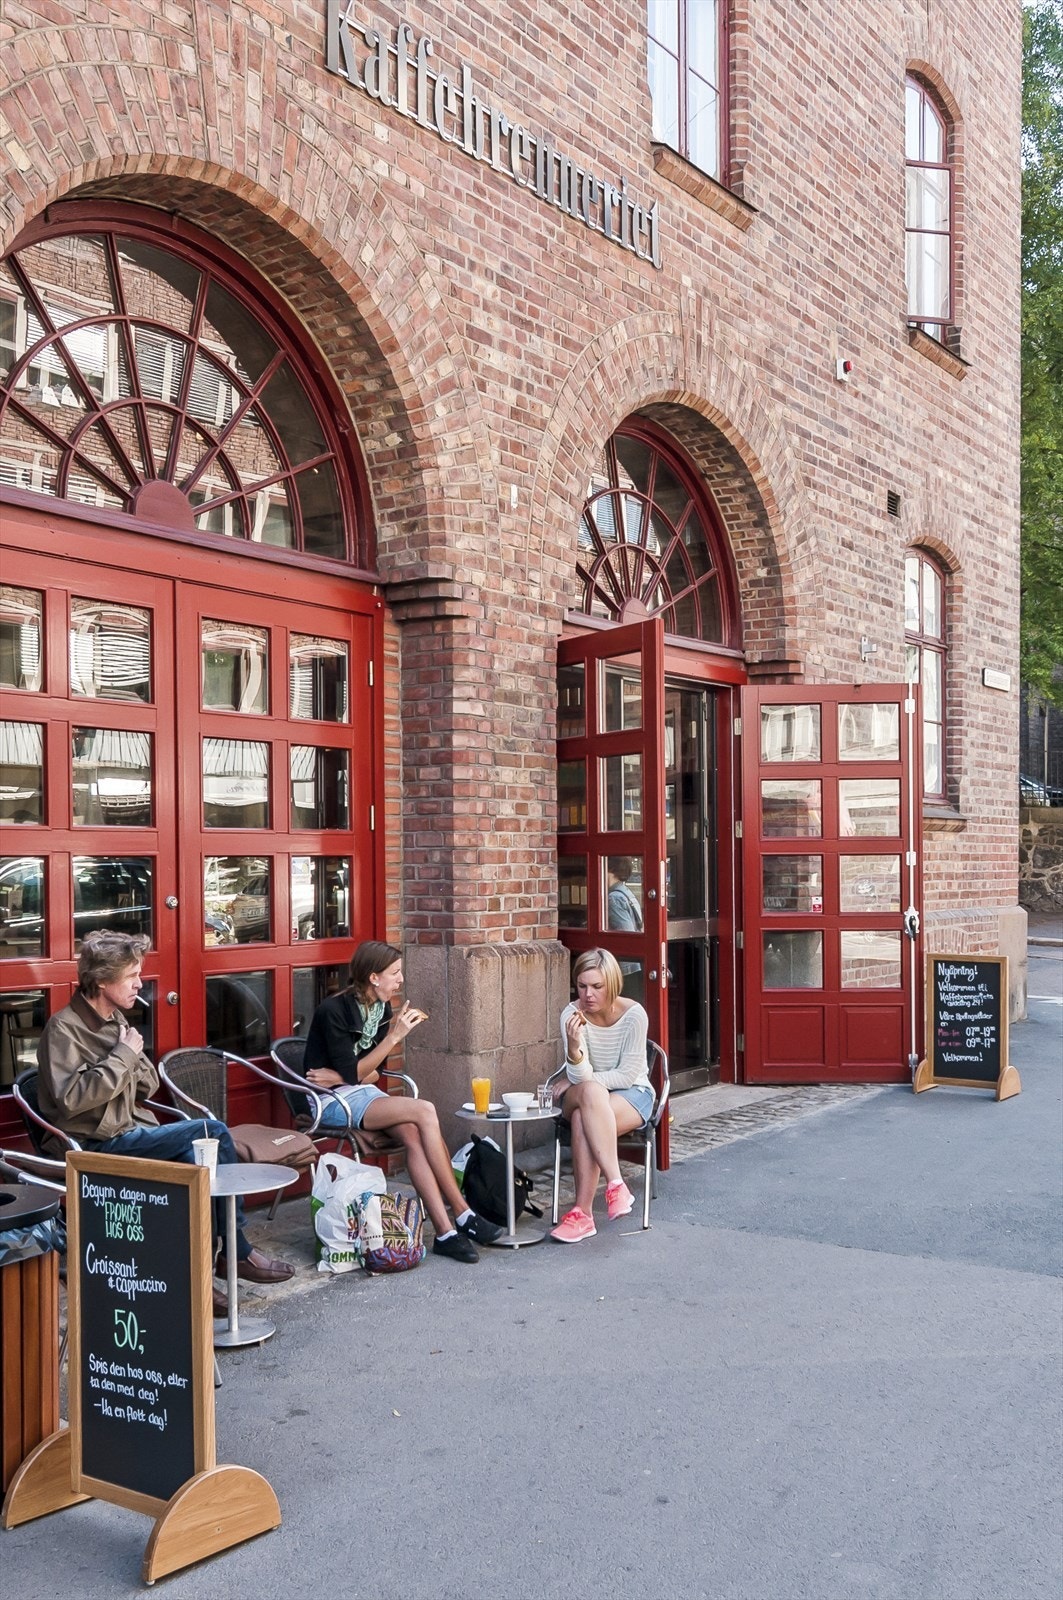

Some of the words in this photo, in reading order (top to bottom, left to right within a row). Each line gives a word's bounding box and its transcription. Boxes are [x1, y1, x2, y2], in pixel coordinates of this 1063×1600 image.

[325, 0, 662, 269] Kaffebrenneriet
[938, 962, 978, 982] Nyåpning!
[938, 982, 976, 991] Velkommen
[942, 1052, 983, 1062] Velkommen!
[82, 1174, 116, 1206] Begynn
[120, 1187, 147, 1206] dagen
[149, 1193, 169, 1206] med
[104, 1202, 143, 1225] FROKOST
[105, 1221, 124, 1239] HOS
[127, 1225, 144, 1242] OSS
[86, 1242, 138, 1278] Croissant
[89, 1353, 108, 1374] Spis
[110, 1362, 126, 1377] den
[127, 1363, 143, 1380] hos
[145, 1369, 167, 1387] oss,
[168, 1373, 189, 1388] eller
[90, 1376, 100, 1389] ta
[101, 1379, 116, 1392] den
[117, 1383, 135, 1397] med
[138, 1388, 159, 1405] deg!
[115, 1406, 126, 1419] en
[127, 1405, 146, 1422] flott
[148, 1409, 168, 1431] dag!
